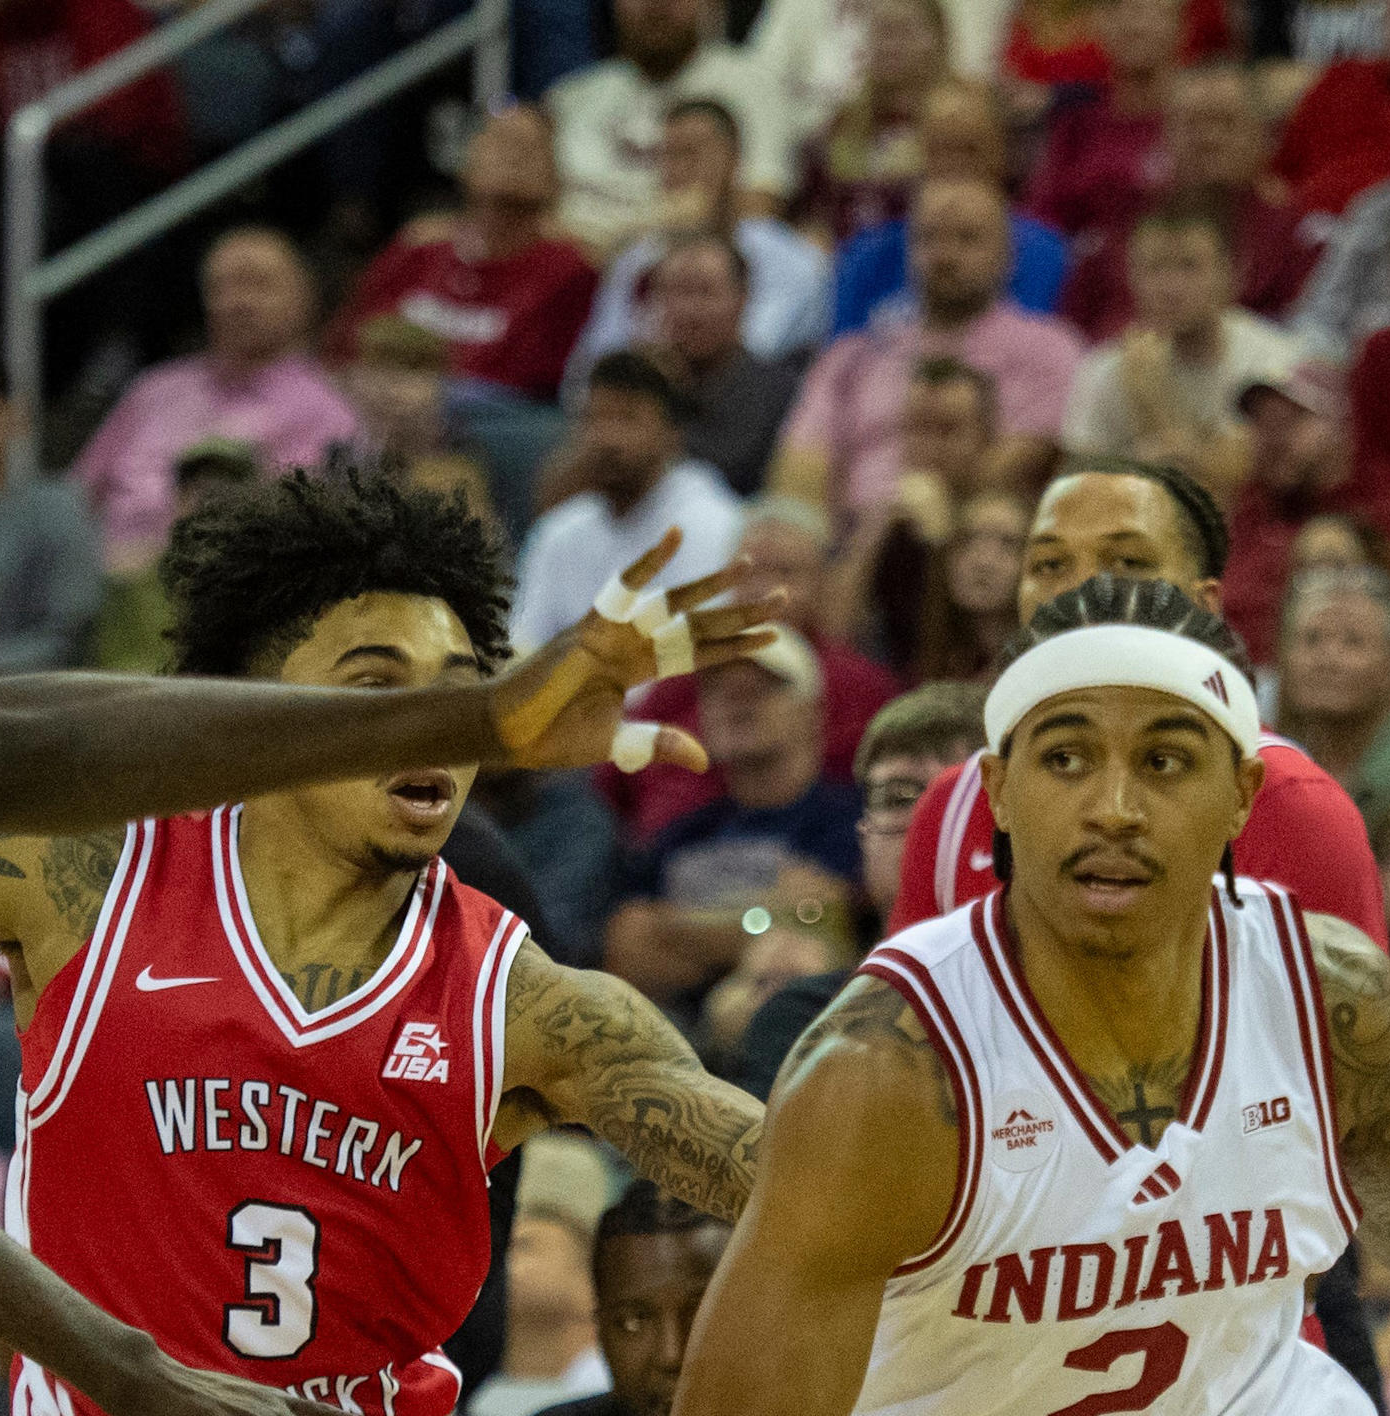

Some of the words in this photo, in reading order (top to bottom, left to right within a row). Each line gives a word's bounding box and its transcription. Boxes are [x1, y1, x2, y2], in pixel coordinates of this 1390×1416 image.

[382, 1055, 450, 1084] USA
[145, 1078, 422, 1192] WESTERN
[991, 1121, 1054, 1140] MERCHANTS
[1007, 1136, 1037, 1150] BANK
[222, 1198, 320, 1361] 3
[951, 1208, 1290, 1324] INDIANA
